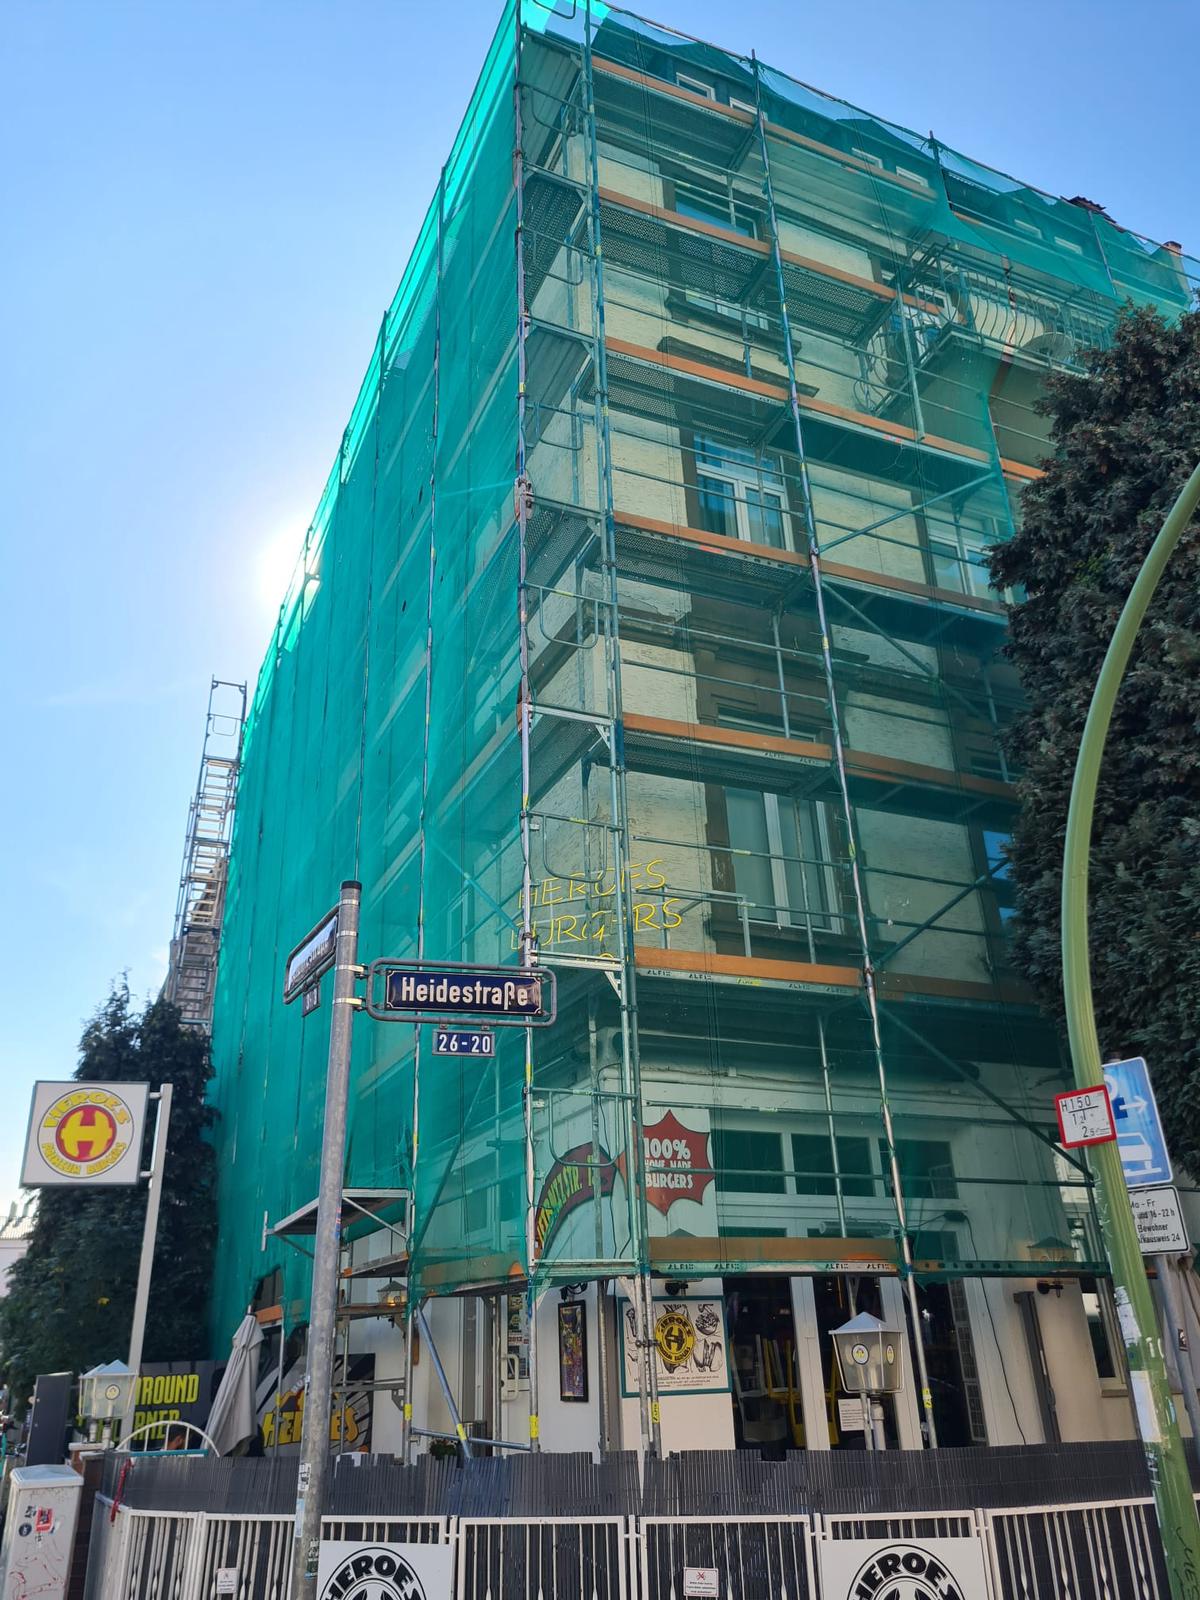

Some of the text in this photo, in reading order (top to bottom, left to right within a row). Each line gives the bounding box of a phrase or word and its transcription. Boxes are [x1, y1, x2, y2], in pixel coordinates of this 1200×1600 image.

[511, 898, 682, 950] URGRS
[402, 977, 528, 1010] Heidestraße
[438, 1034, 490, 1053] 26-20
[43, 1091, 131, 1128] HEROES
[643, 1138, 691, 1160] 100%
[646, 1173, 694, 1189] BURGERS
[1137, 1224, 1168, 1233] Bewohner
[1171, 1233, 1181, 1242] 24
